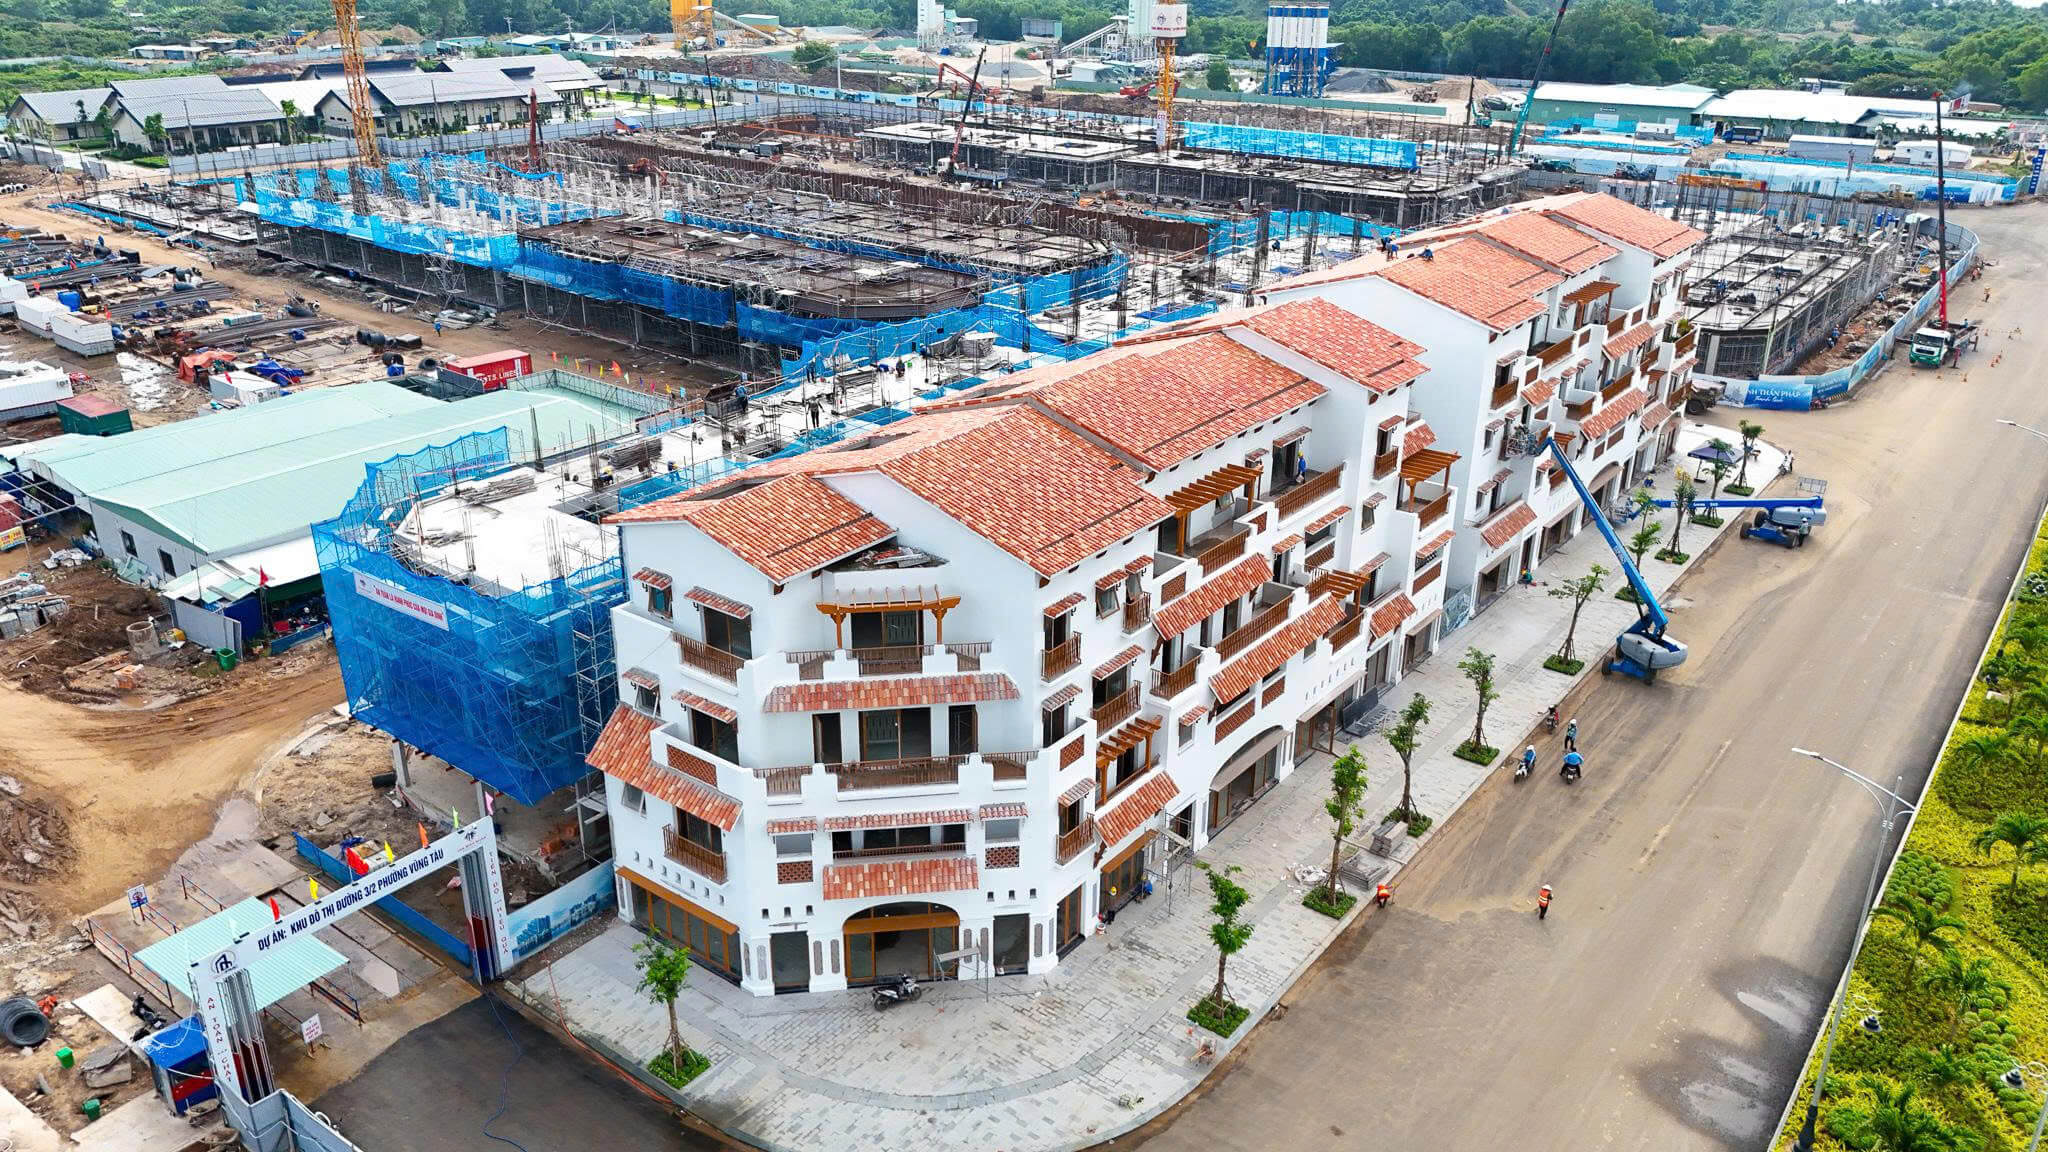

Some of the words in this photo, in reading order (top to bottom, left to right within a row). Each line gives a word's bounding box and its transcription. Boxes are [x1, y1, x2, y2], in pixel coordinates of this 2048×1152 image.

[257, 935, 271, 951] DỰ
[272, 926, 288, 944] ÁN:
[290, 919, 308, 934] KHU
[321, 904, 336, 923] THỊ
[336, 889, 364, 912] ĐƯỜNG
[364, 883, 377, 898] 3/2
[377, 868, 409, 893] PHƯỜNG
[409, 857, 430, 876] VŨNG
